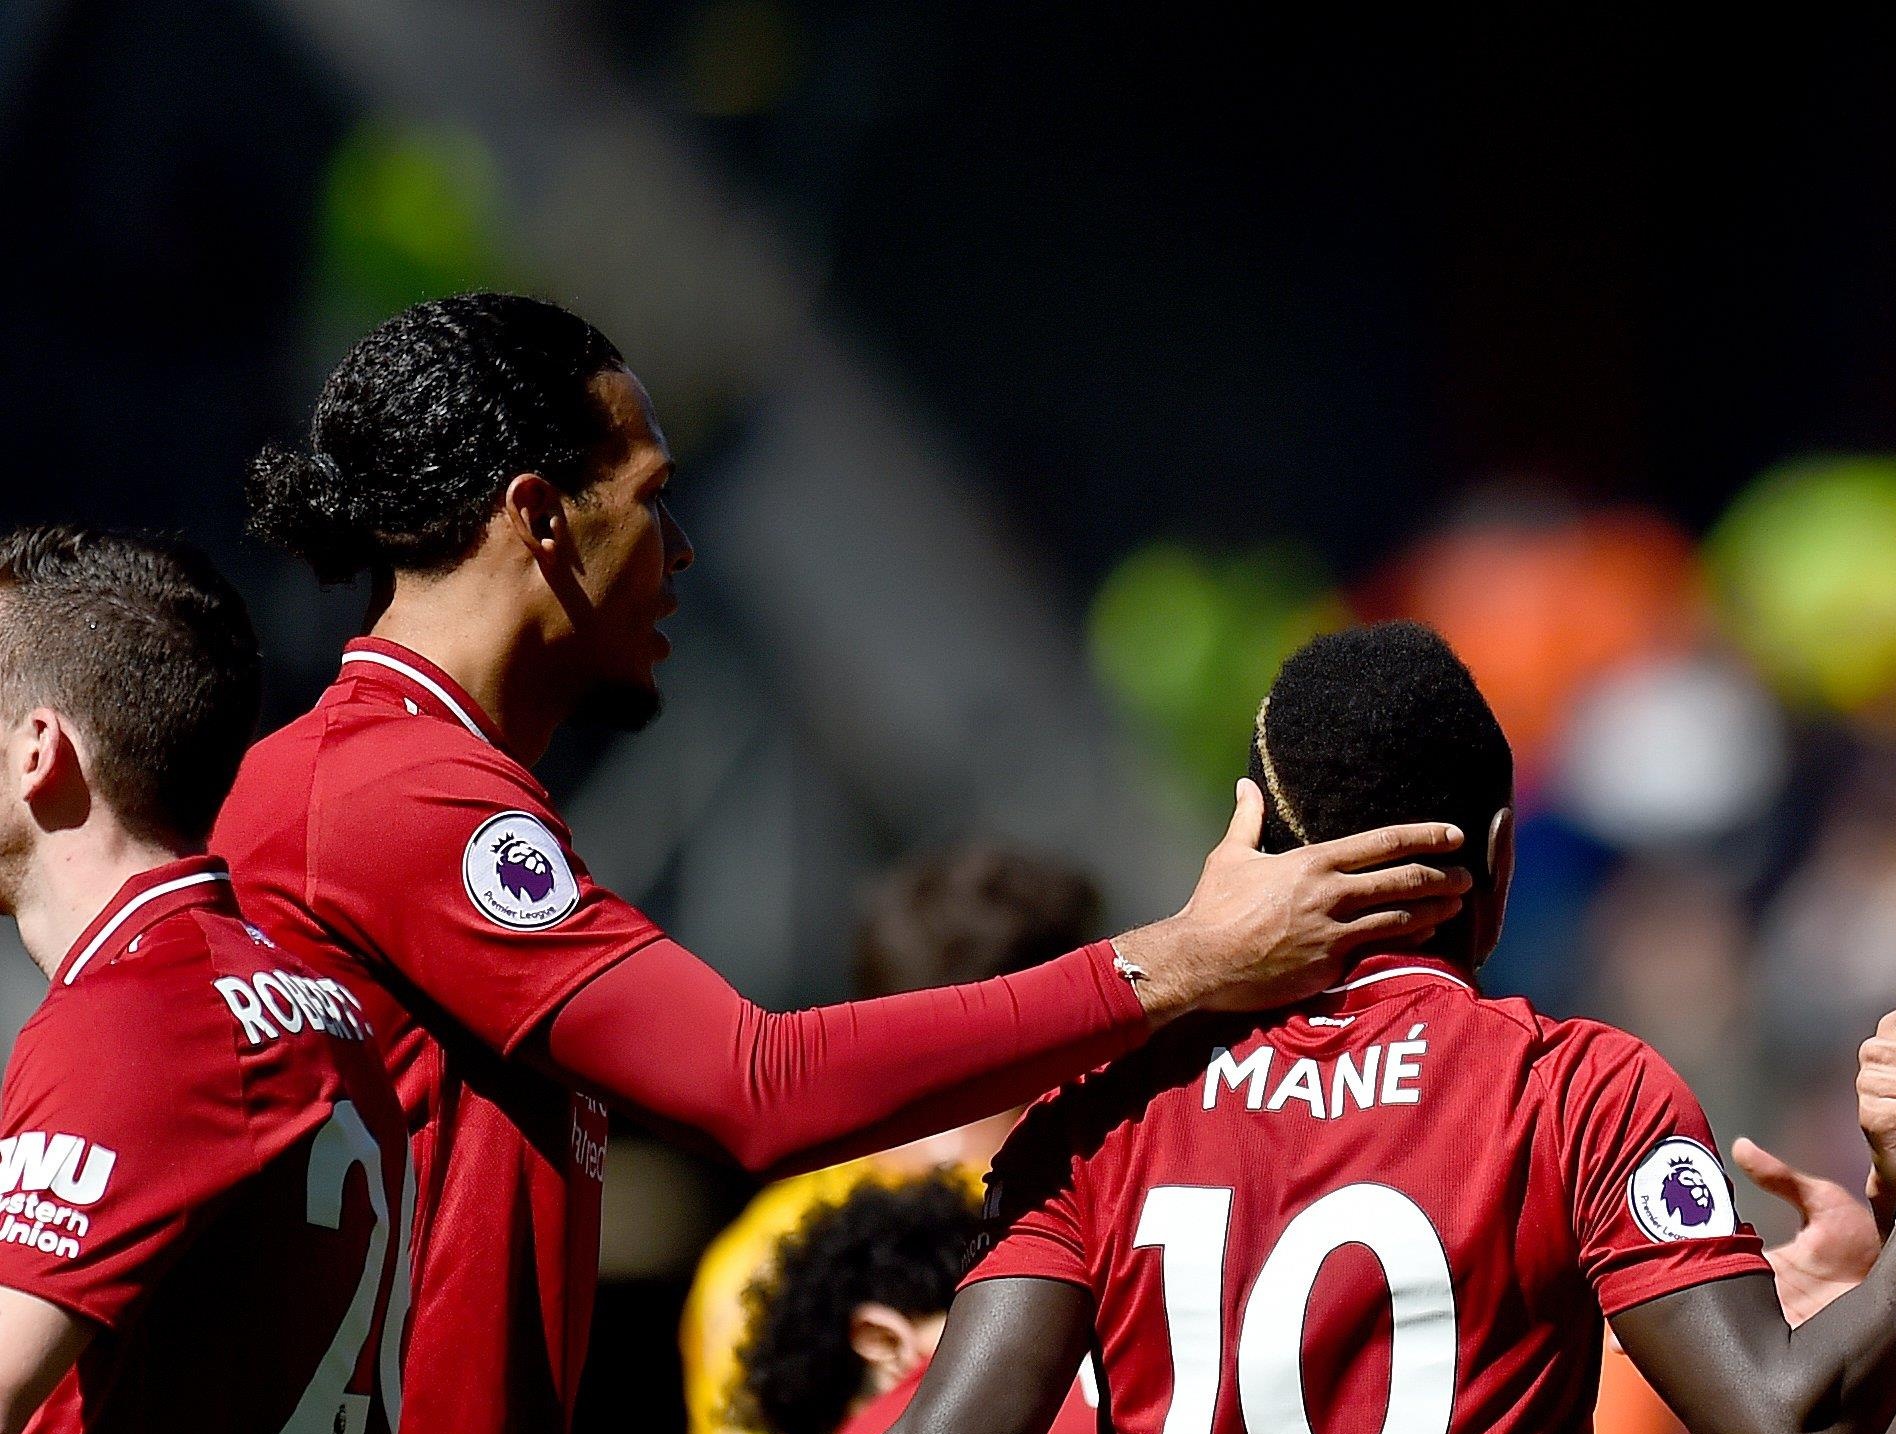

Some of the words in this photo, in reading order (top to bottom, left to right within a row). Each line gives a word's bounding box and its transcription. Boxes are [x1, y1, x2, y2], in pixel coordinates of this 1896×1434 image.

[484, 890, 518, 918] Premier
[520, 906, 557, 919] League
[1202, 1023, 1428, 1120] MANÉ
[0, 1191, 90, 1238] stern
